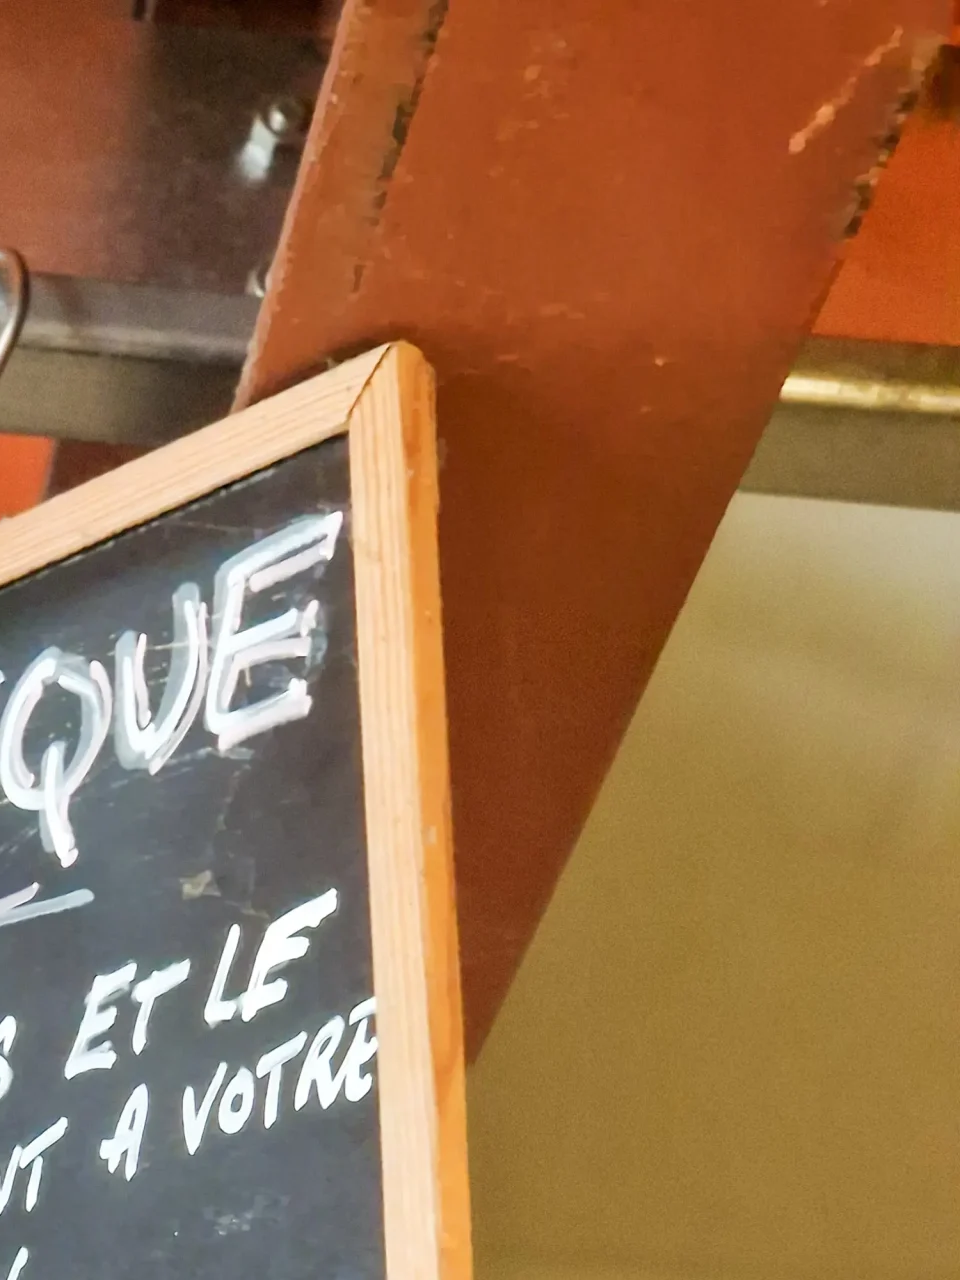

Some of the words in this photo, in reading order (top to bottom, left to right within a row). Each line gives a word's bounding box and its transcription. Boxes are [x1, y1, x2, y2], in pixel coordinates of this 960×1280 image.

[63, 957, 192, 1081] ET
[203, 887, 338, 1029] LE
[98, 1082, 149, 1182] A
[182, 997, 379, 1156] VOTRE
